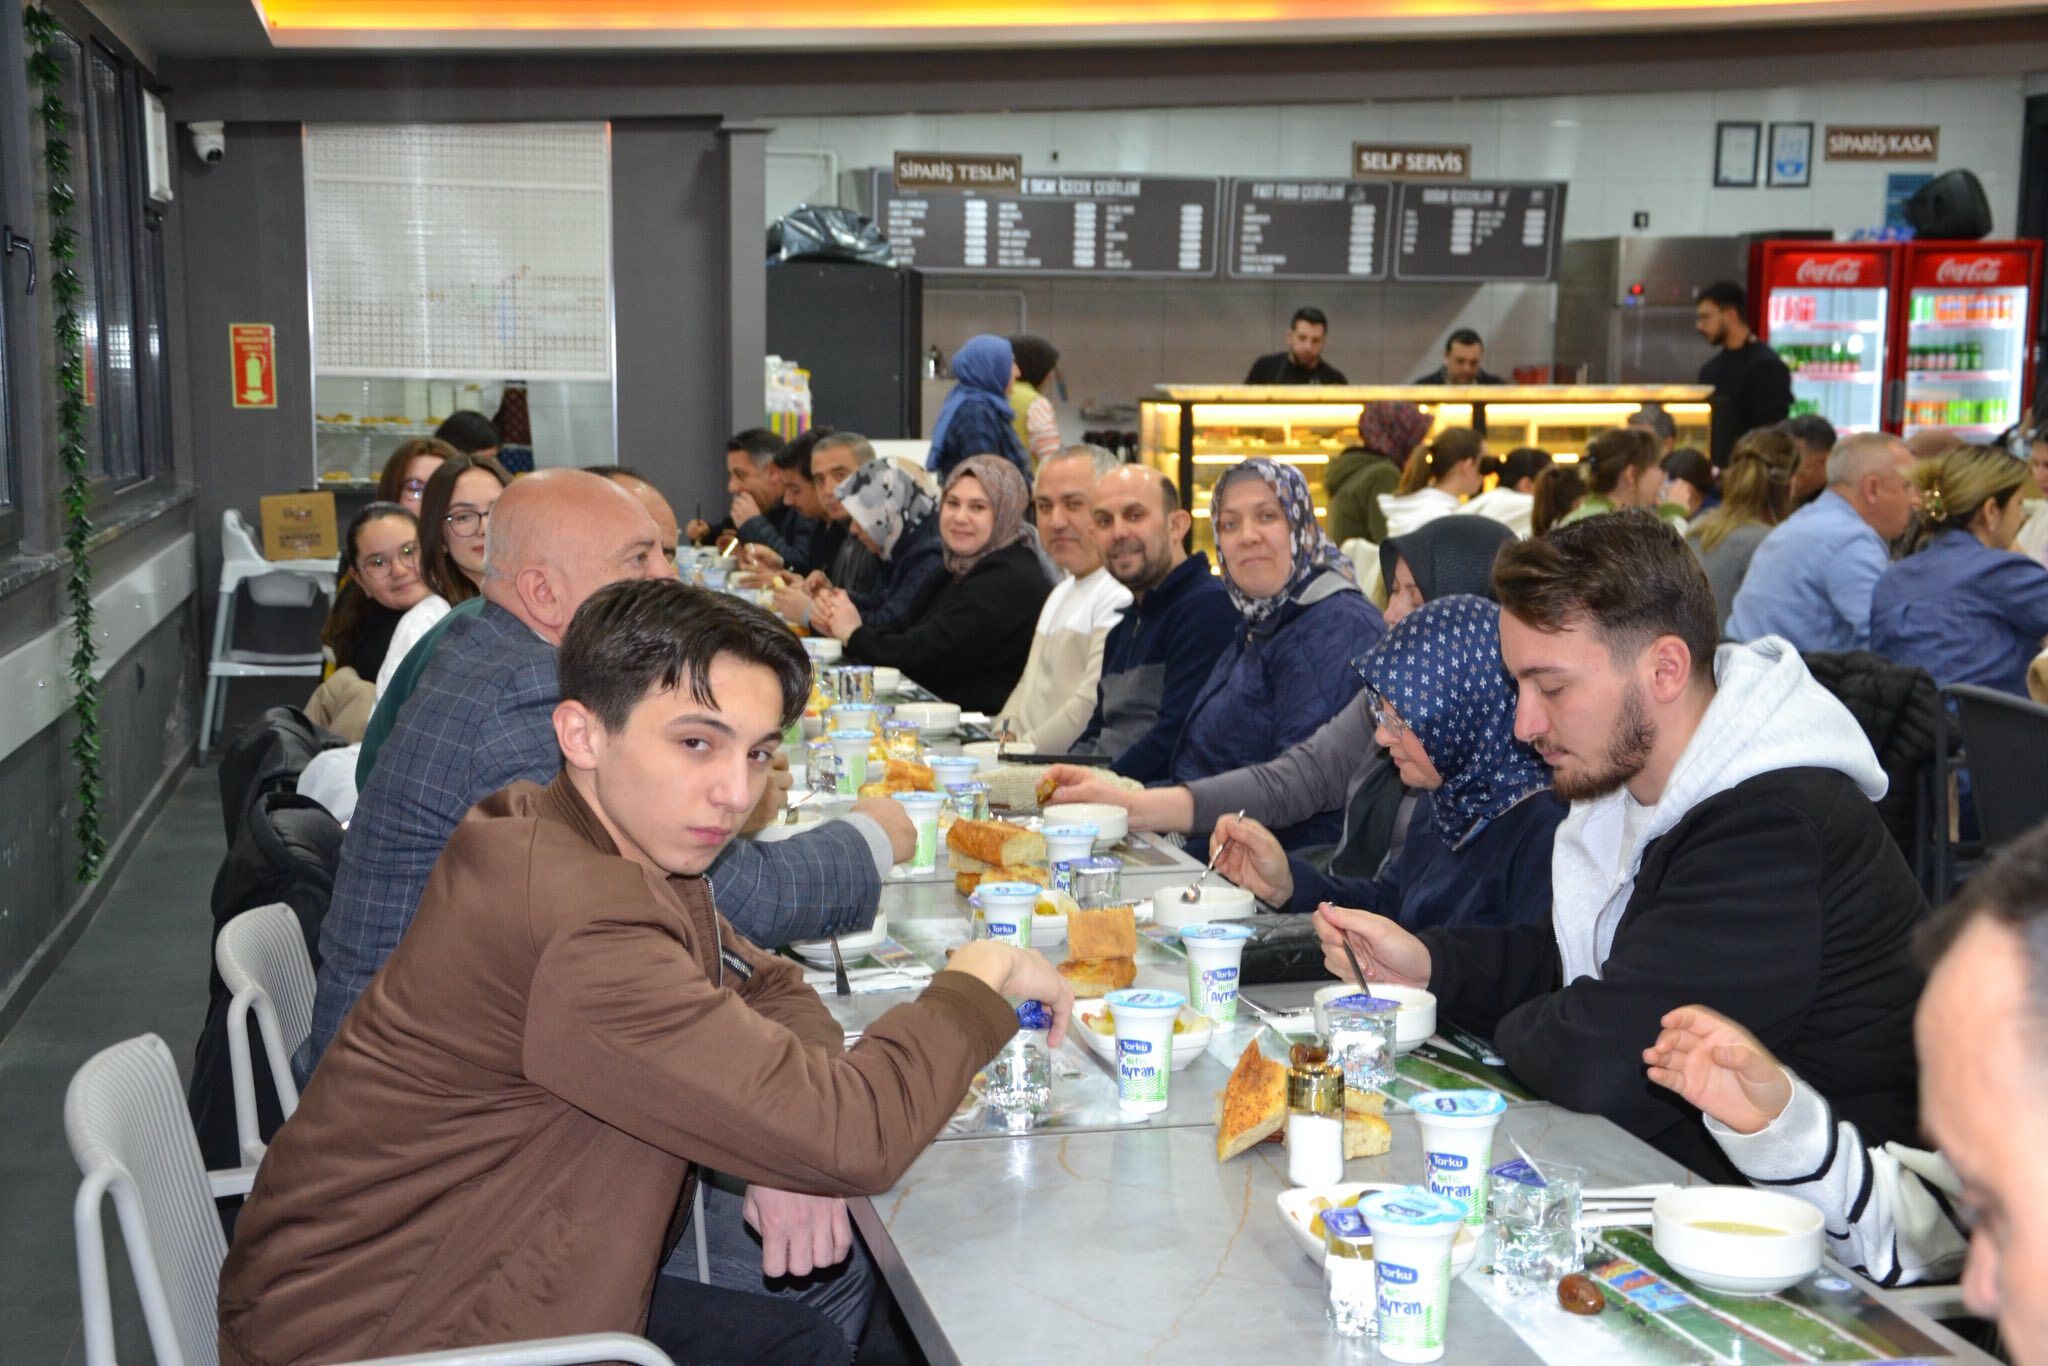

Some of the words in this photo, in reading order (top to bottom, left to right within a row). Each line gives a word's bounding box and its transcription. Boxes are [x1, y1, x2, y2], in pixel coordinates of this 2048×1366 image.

[1830, 131, 1887, 156] SİPARİŞ
[1889, 134, 1934, 154] KASA
[1361, 152, 1403, 171] SELF
[1405, 150, 1463, 172] SERVİS
[900, 160, 954, 183] SİPARİŞ
[957, 161, 1015, 182] TESLİM
[992, 925, 1014, 933] Torku
[1124, 1041, 1148, 1051] Torku
[1122, 1064, 1155, 1079] Ayran
[1432, 1154, 1464, 1168] Torku
[1431, 1181, 1471, 1199] Ayran
[1382, 1264, 1413, 1280] Torku
[1379, 1294, 1422, 1317] Ayran
